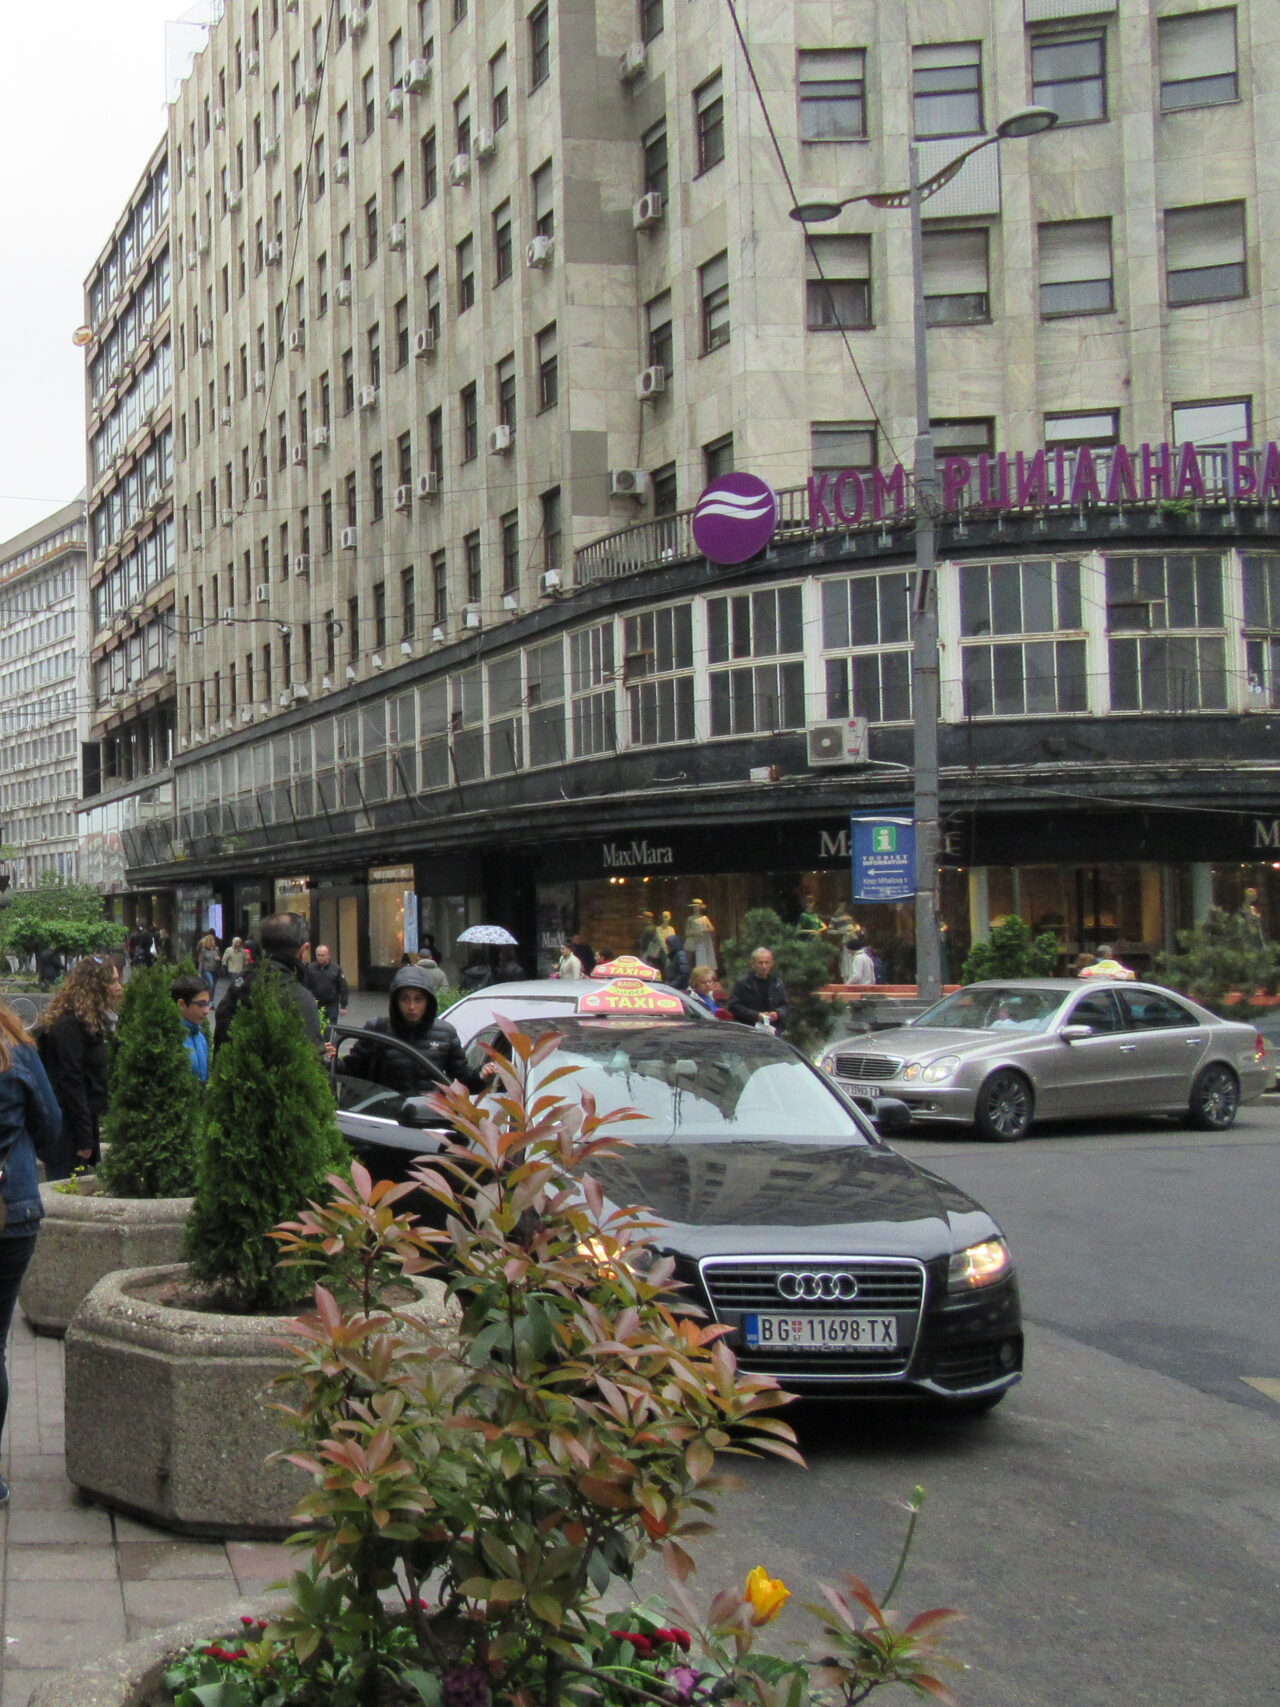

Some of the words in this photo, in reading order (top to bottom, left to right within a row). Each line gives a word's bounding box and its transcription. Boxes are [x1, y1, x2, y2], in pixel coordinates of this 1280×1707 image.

[807, 441, 1204, 531] КОМРЦИЈАЛНА
[602, 840, 673, 867] MaxMara
[610, 966, 639, 976] TAXI
[606, 996, 655, 1009] TAXI
[762, 1318, 790, 1341] BG
